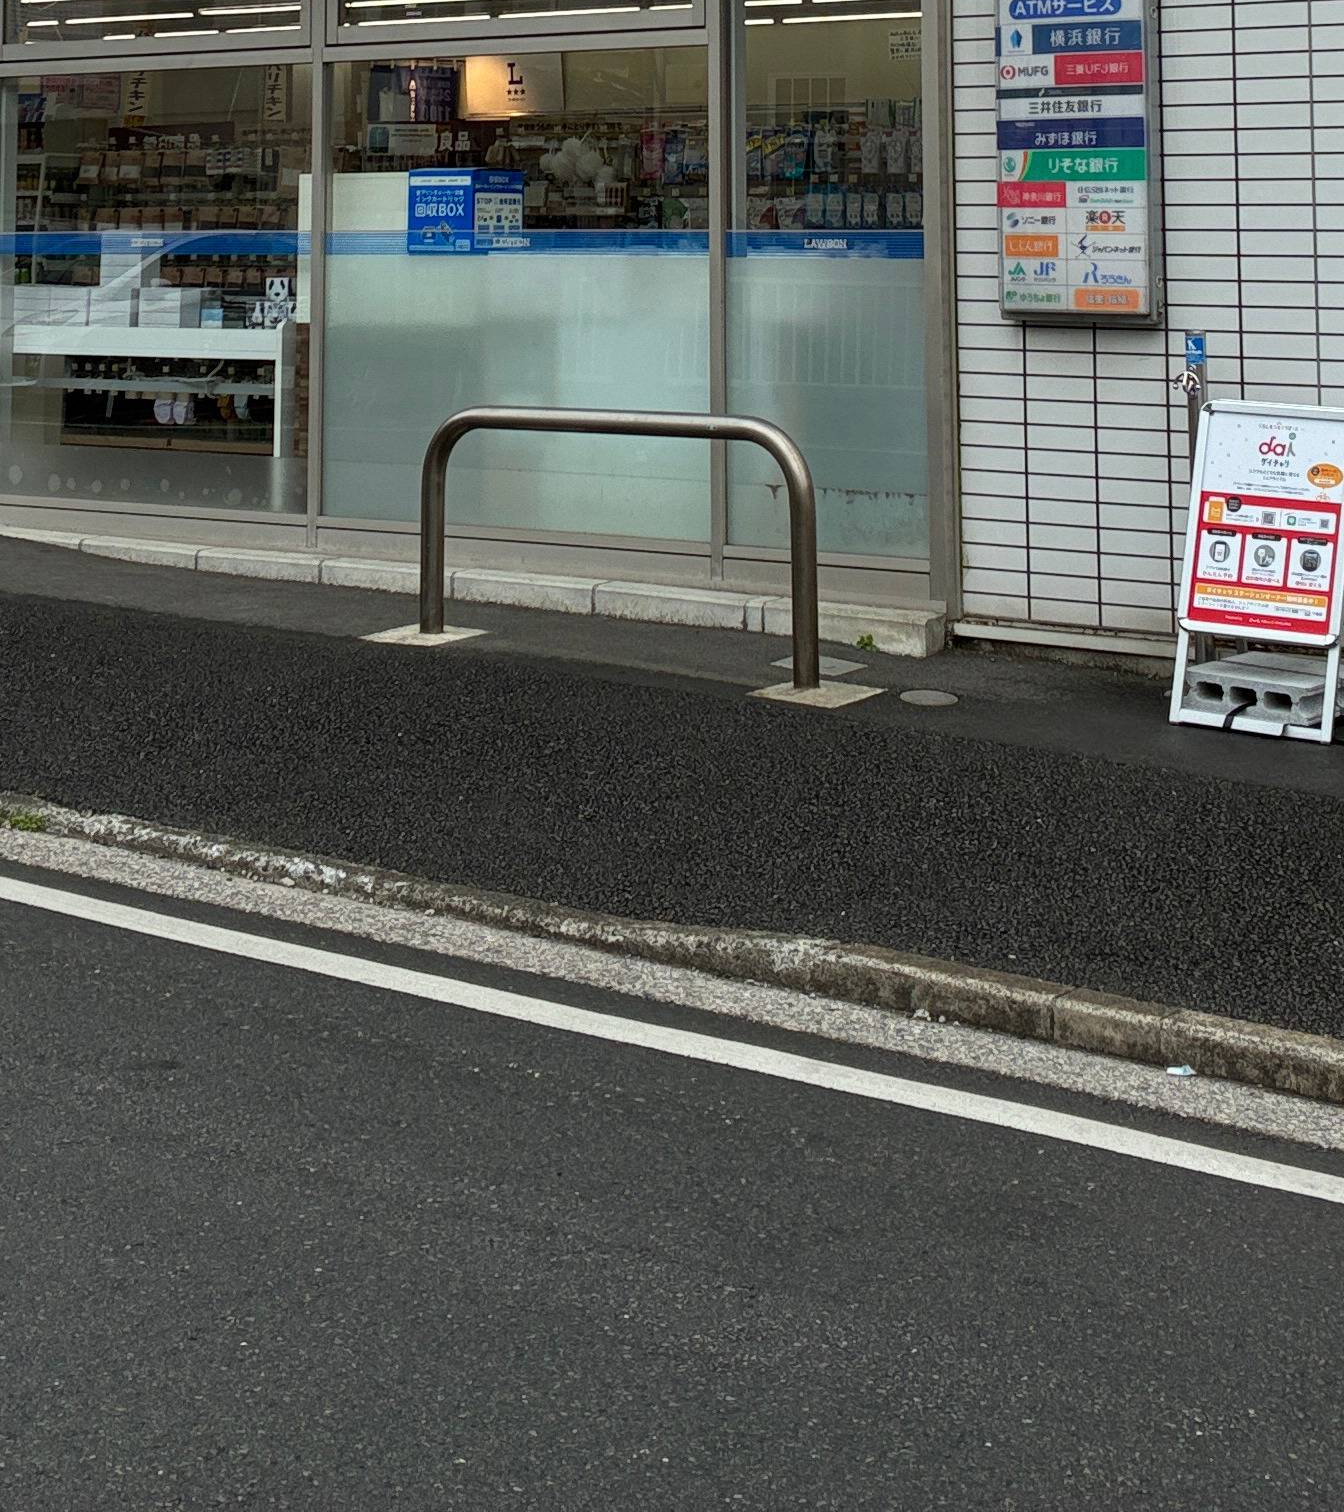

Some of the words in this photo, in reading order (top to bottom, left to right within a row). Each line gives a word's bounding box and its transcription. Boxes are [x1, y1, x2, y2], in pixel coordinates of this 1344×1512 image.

[1050, 28, 1121, 47] 横浜銀行
[507, 62, 523, 85] L
[1017, 65, 1049, 77] MUFG
[1066, 63, 1129, 75] 三菱UFJ銀行
[1028, 99, 1102, 114] 三井住友銀行
[1034, 131, 1097, 146] みずほ銀行
[1048, 157, 1119, 173] りそな銀行
[415, 203, 465, 218] 回収BOX
[803, 238, 848, 249] LAWSON
[1008, 262, 1027, 276] JA
